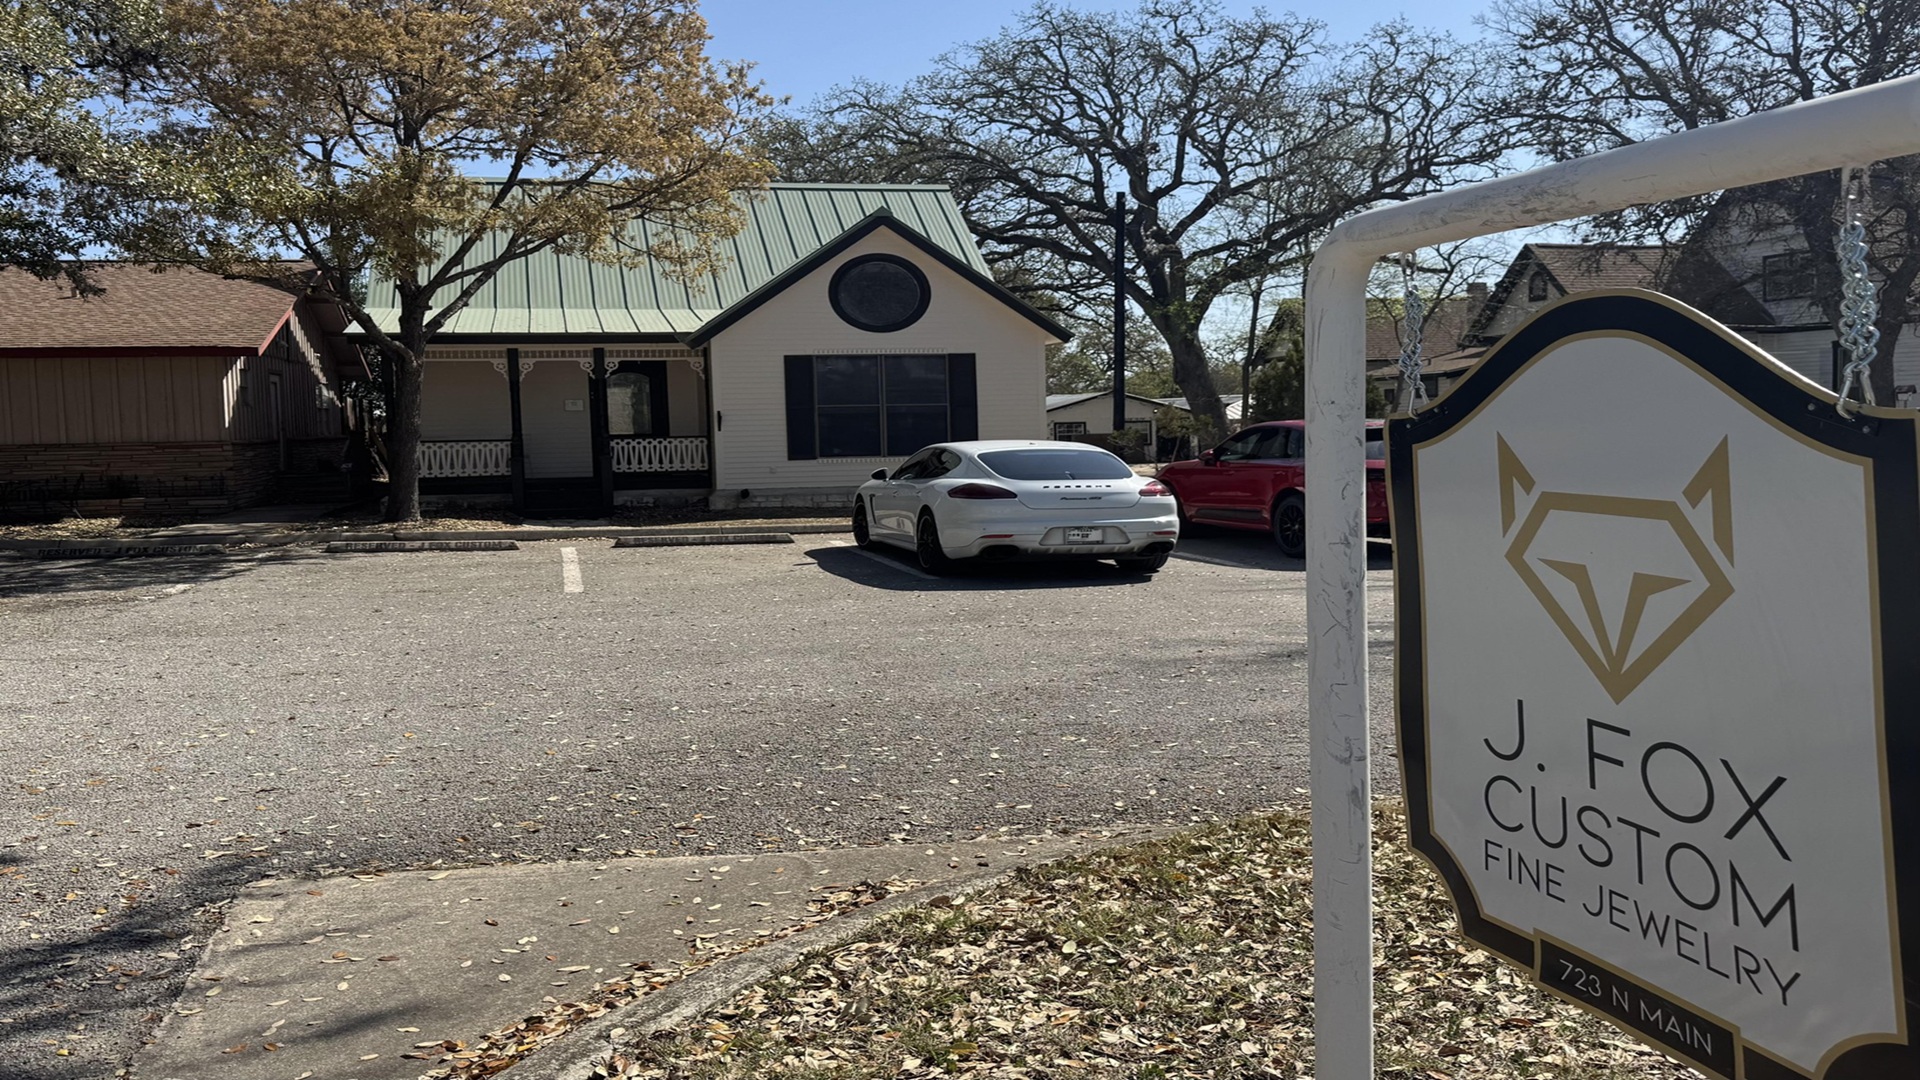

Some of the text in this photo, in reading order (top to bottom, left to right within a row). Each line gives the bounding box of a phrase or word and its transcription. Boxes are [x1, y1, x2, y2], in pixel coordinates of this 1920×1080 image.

[37, 547, 102, 556] RESERVED
[125, 546, 150, 554] FOX
[152, 545, 204, 554] CUSTOM
[345, 542, 406, 550] RESERVED
[454, 541, 502, 549] CUSTOM
[1483, 699, 1792, 862] J. FOX
[1484, 775, 1800, 952] CUSTOM
[1484, 839, 1801, 1006] FINE JEWELRY
[1559, 959, 1712, 1056] 723 N MAIN
